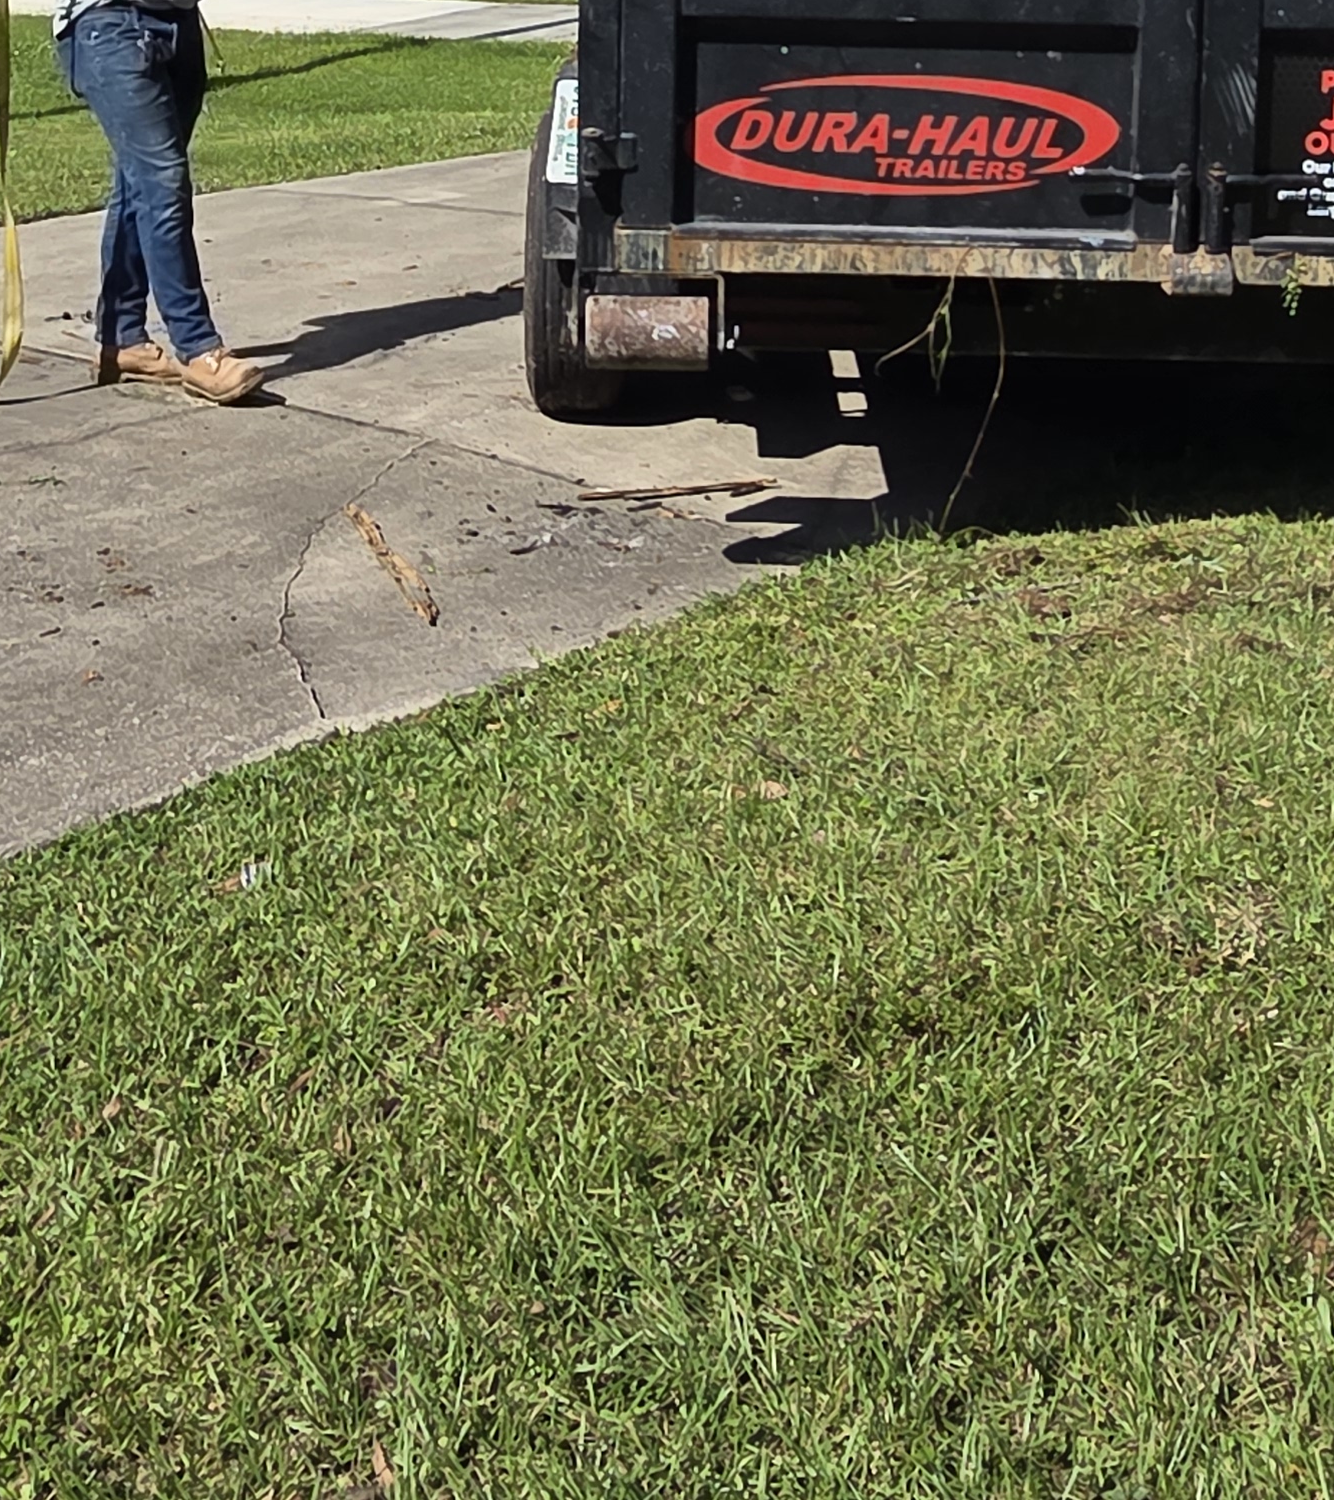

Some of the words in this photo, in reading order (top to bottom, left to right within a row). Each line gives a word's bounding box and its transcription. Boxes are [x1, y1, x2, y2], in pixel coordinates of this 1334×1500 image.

[729, 111, 1065, 159] DURA-HAUL
[876, 157, 1027, 182] TRAILERS
[1302, 159, 1331, 175] Our
